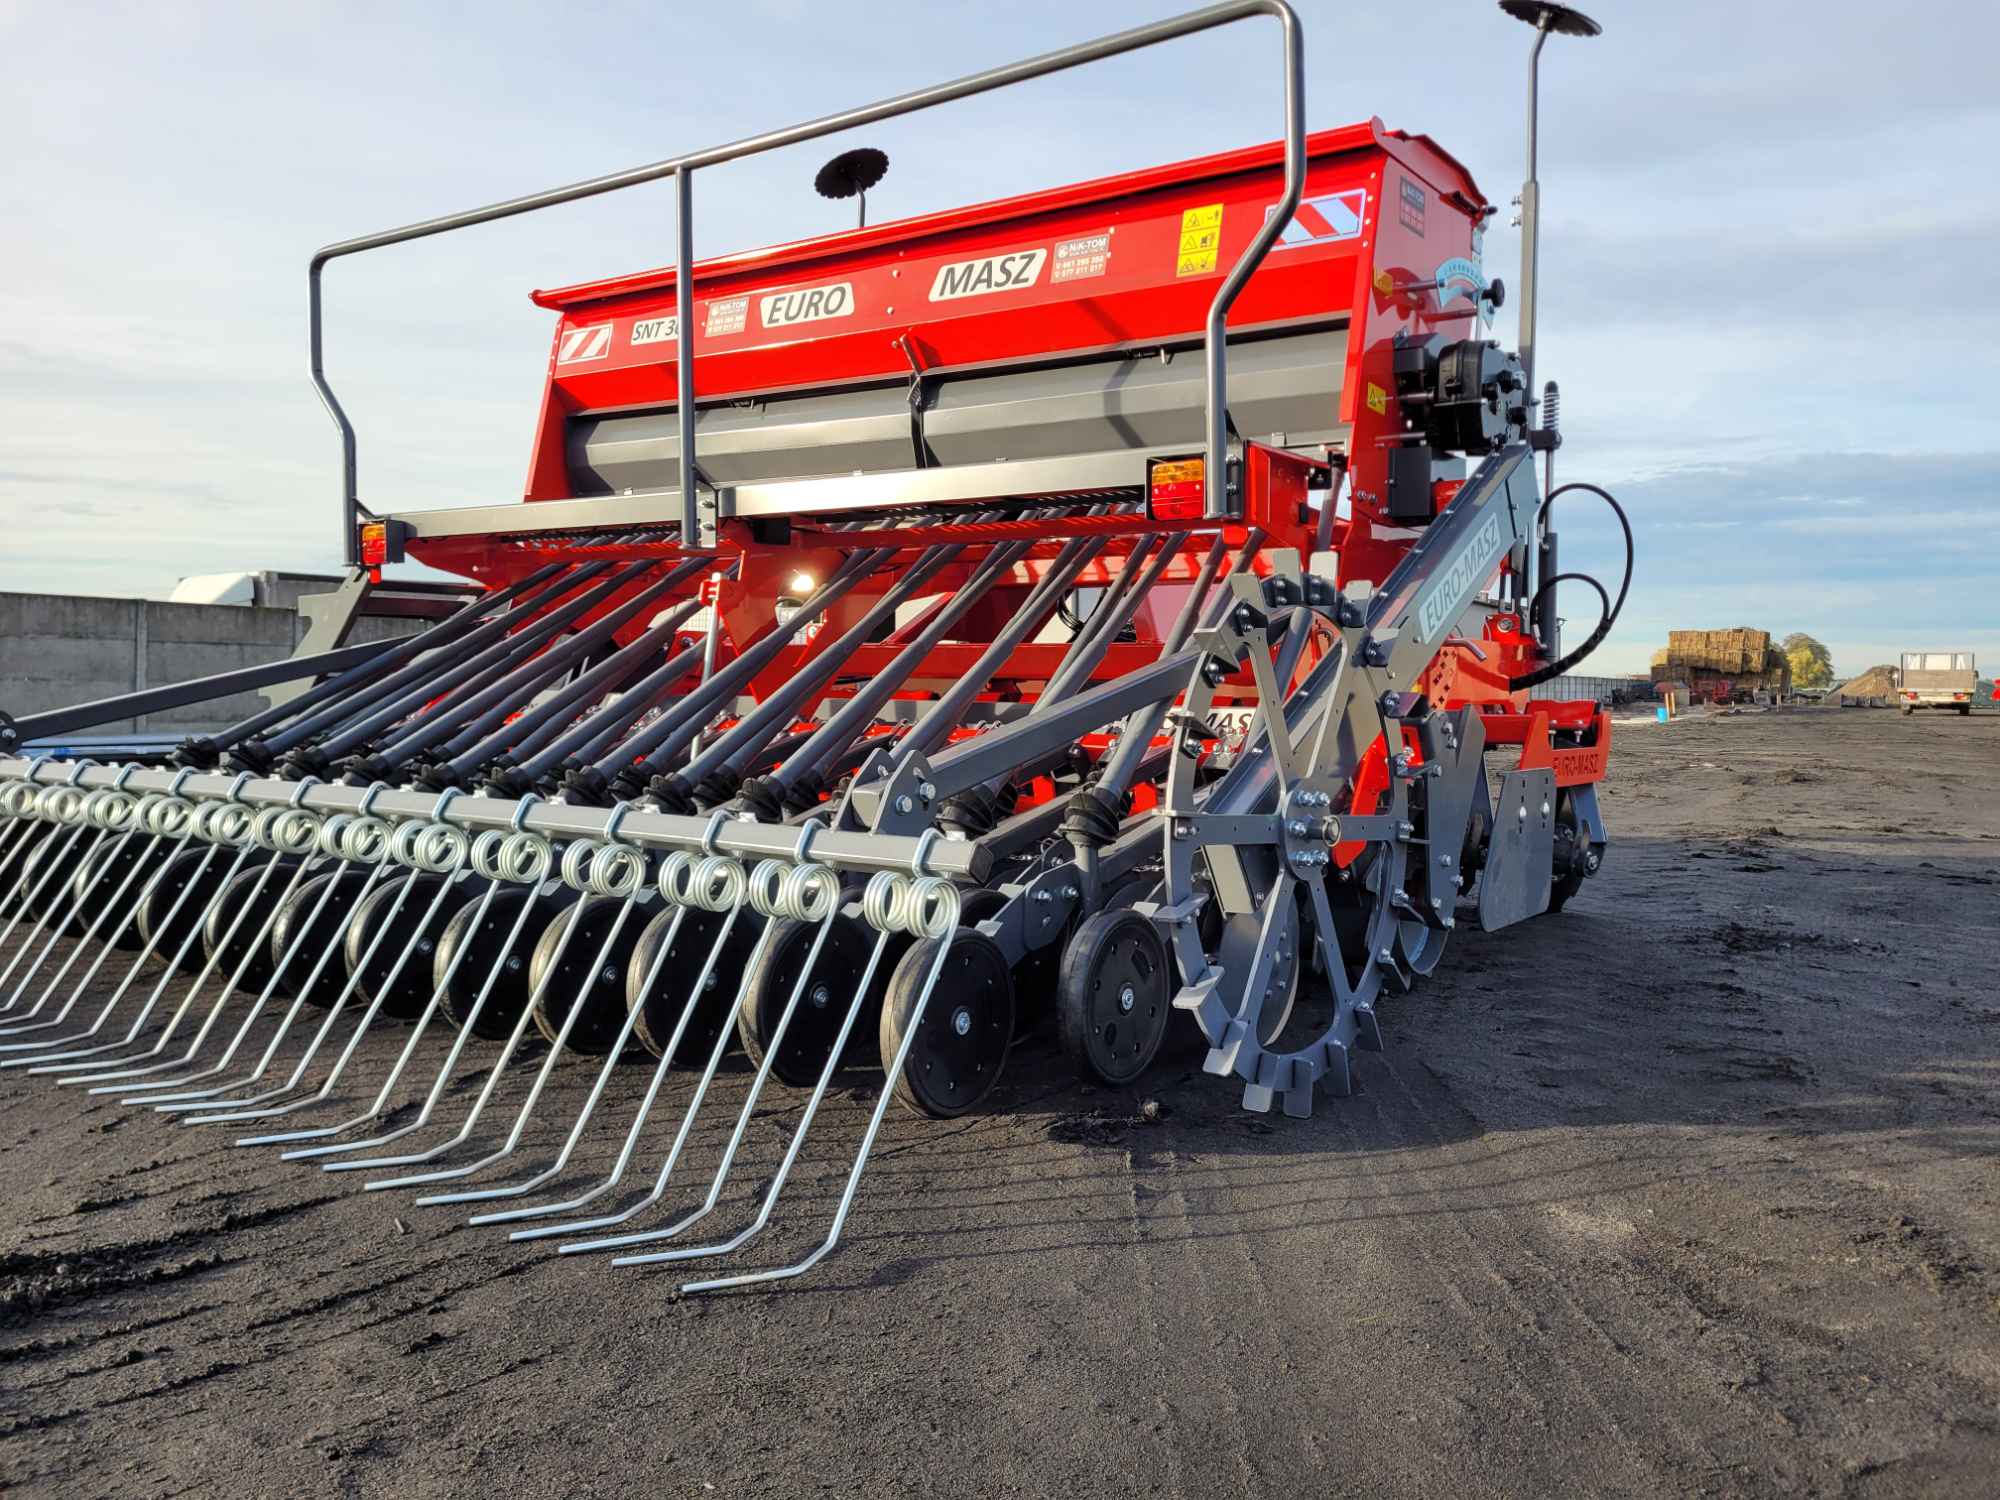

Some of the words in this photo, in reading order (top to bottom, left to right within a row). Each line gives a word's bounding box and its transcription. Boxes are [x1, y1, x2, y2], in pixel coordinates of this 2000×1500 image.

[939, 252, 1037, 296] MASZ
[767, 286, 846, 324] EURO
[632, 320, 664, 341] SNT
[1425, 520, 1498, 633] EURO-MASZ
